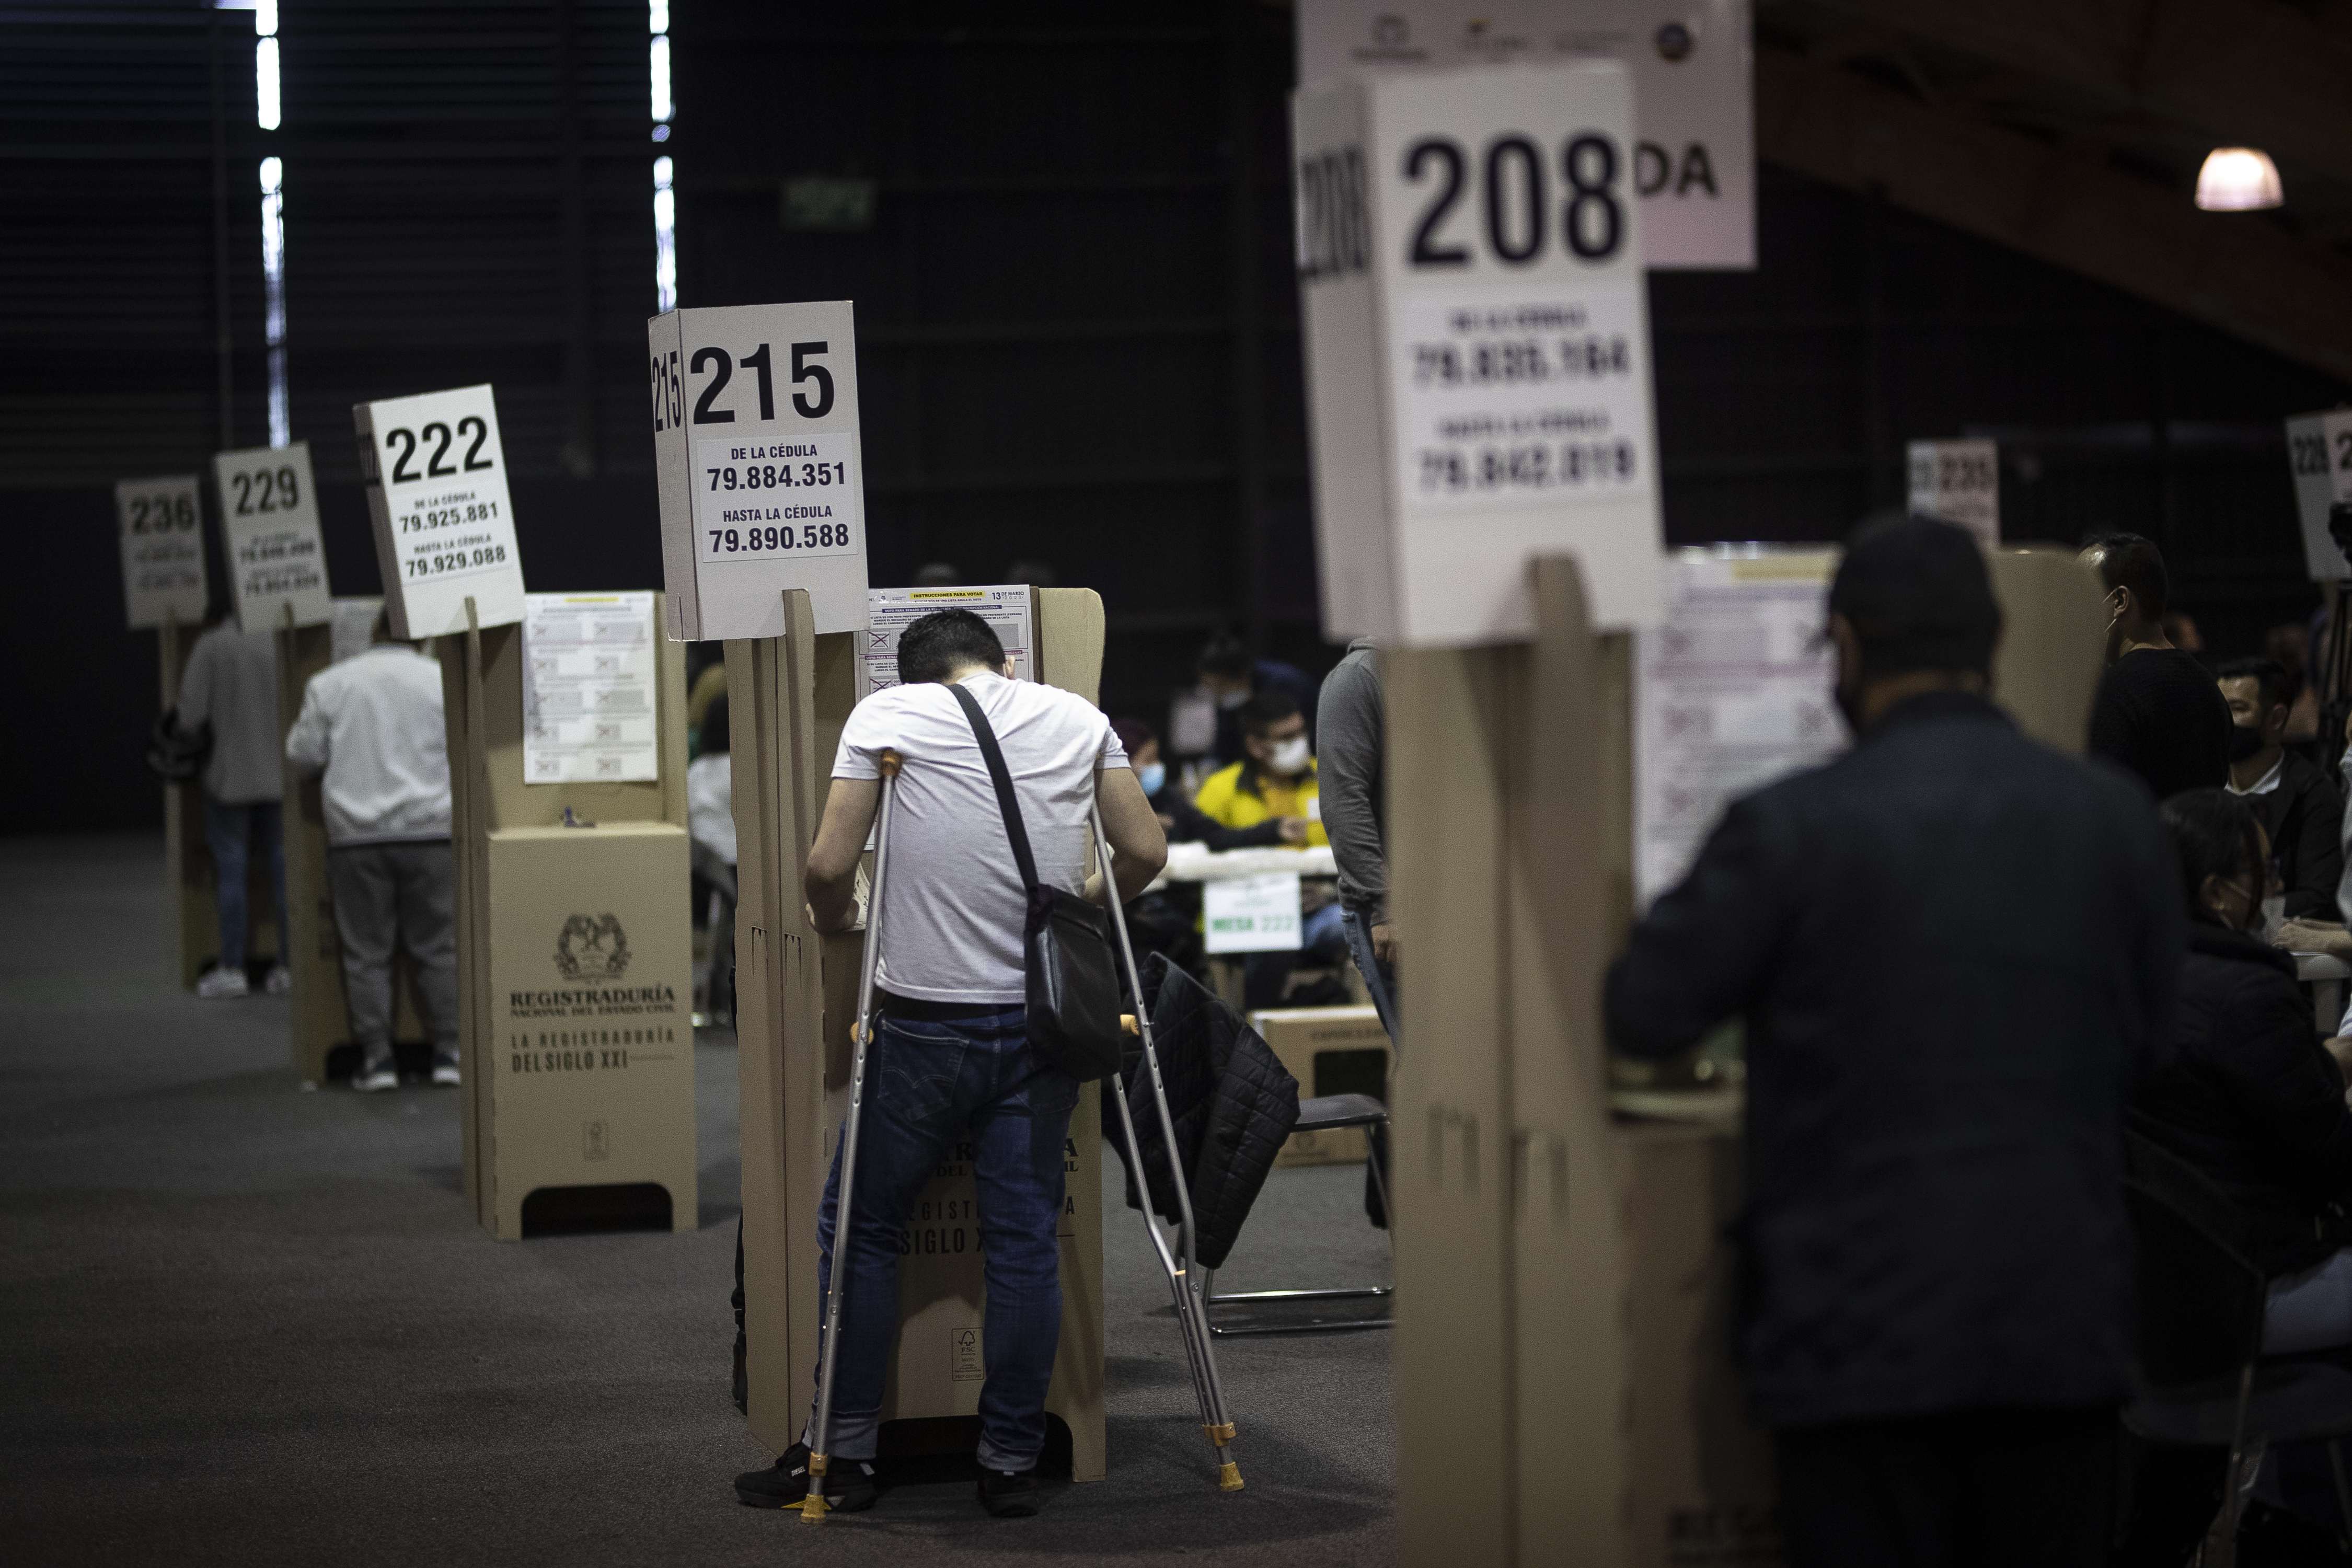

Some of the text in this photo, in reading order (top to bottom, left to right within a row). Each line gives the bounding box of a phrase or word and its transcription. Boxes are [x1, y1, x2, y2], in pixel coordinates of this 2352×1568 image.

[1405, 132, 1624, 269] 208
[652, 350, 681, 433] 215
[690, 341, 834, 425] 215
[386, 416, 493, 484] 222
[731, 443, 817, 460] DE LA CÉDULA
[232, 465, 299, 517] 229
[707, 462, 845, 491] 79.884.351
[130, 492, 195, 535] 236
[399, 502, 498, 533] 79.925.881
[723, 505, 832, 523] HASTA LA CÉDULA
[709, 523, 849, 553] 79.890.588
[406, 545, 505, 578] 79.929.088
[511, 984, 674, 1007] REGISTRADURÍA
[512, 1049, 627, 1072] DEL SIGLO XXI
[900, 1228, 965, 1255] SIGLO
